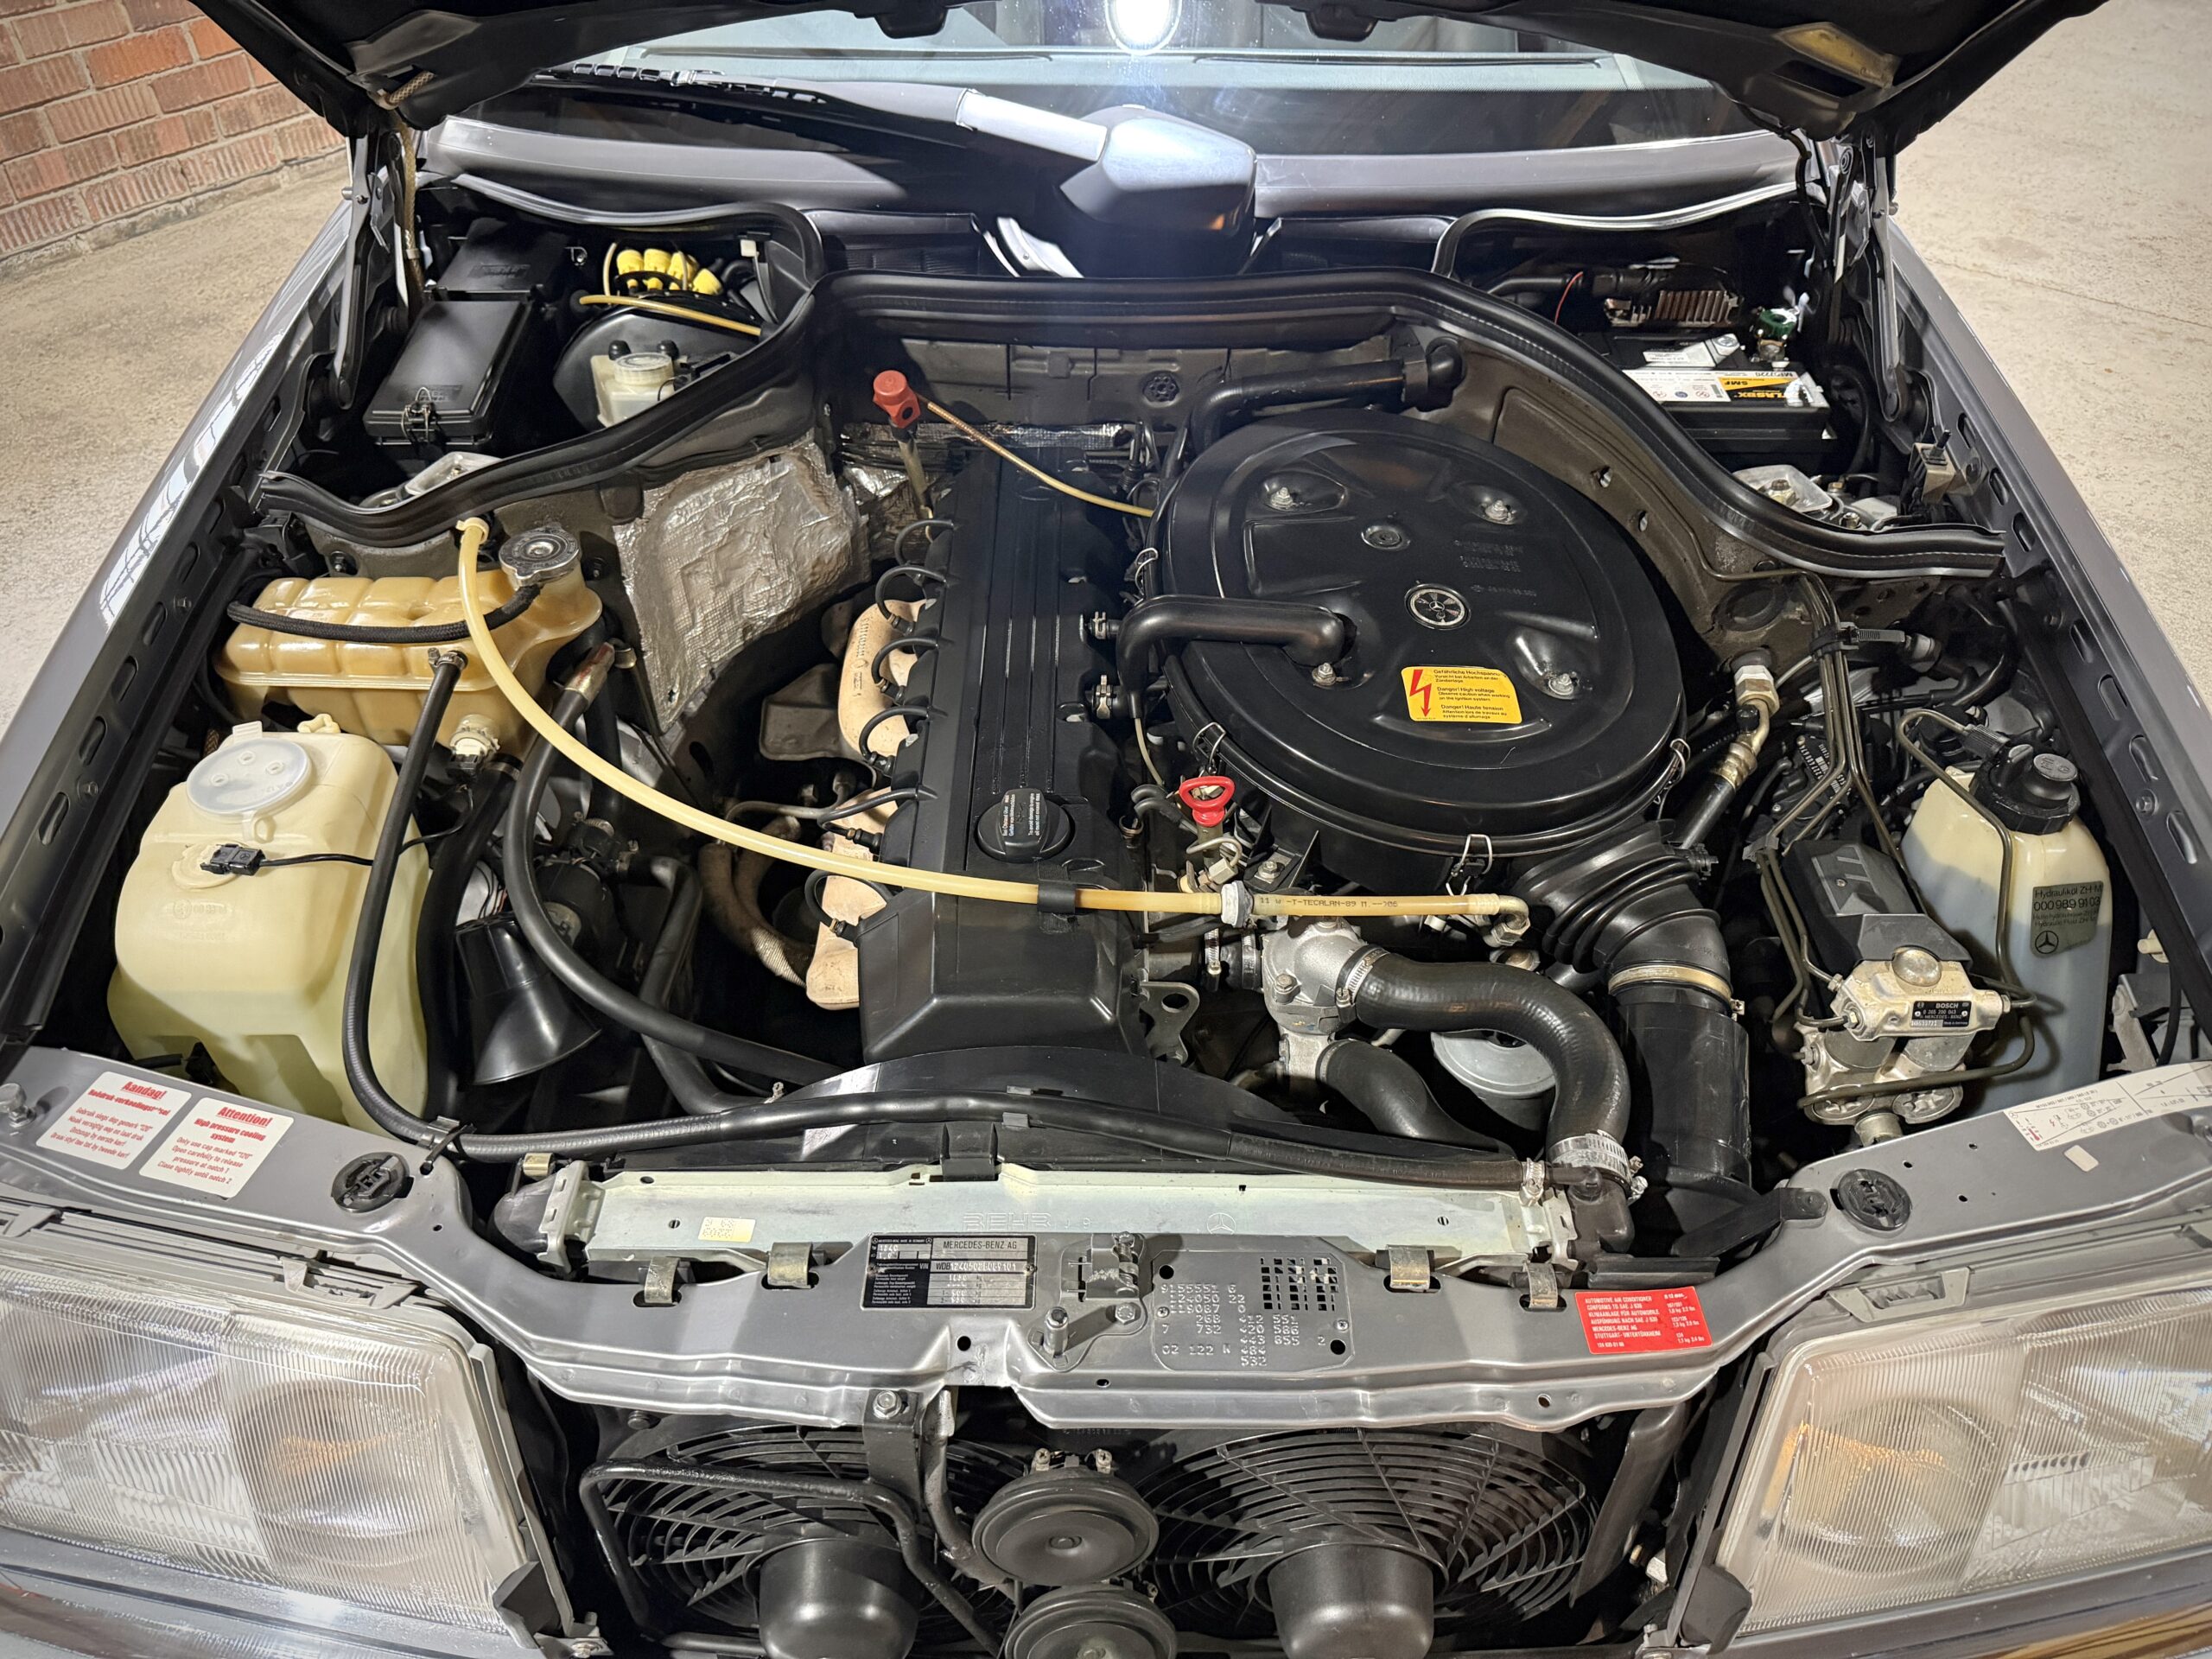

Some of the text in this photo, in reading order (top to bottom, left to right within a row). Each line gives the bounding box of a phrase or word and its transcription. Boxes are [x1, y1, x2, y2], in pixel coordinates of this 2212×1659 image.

[2034, 897, 2101, 911] 000 989 91 03
[122, 1081, 167, 1100] Aandag!
[217, 1106, 272, 1128] Attention!
[194, 1118, 266, 1141] High pressure cooling
[210, 1133, 236, 1144] system
[176, 1137, 189, 1146] Only
[201, 1143, 213, 1152] cap
[215, 1146, 237, 1157] marked
[172, 1146, 187, 1154] Open
[187, 1148, 214, 1161] carefully
[221, 1158, 244, 1168] release
[157, 1160, 173, 1170] Close
[174, 1166, 194, 1176] tightly
[194, 1170, 208, 1179] until
[208, 1173, 226, 1183] notch
[173, 1156, 200, 1166] pressure
[207, 1164, 225, 1173] notch
[963, 1212, 1052, 1230] BEHR
[1161, 1284, 1219, 1294] 9155551
[1170, 1294, 1245, 1303] 124050 22
[1239, 1314, 1263, 1324] 412
[1273, 1314, 1299, 1325] 551
[1162, 1324, 1300, 1335] 7 732 420 586
[1318, 1336, 1325, 1345] 2
[1162, 1344, 1179, 1355] 02
[1189, 1345, 1214, 1356] 122
[1240, 1356, 1268, 1366] 532
